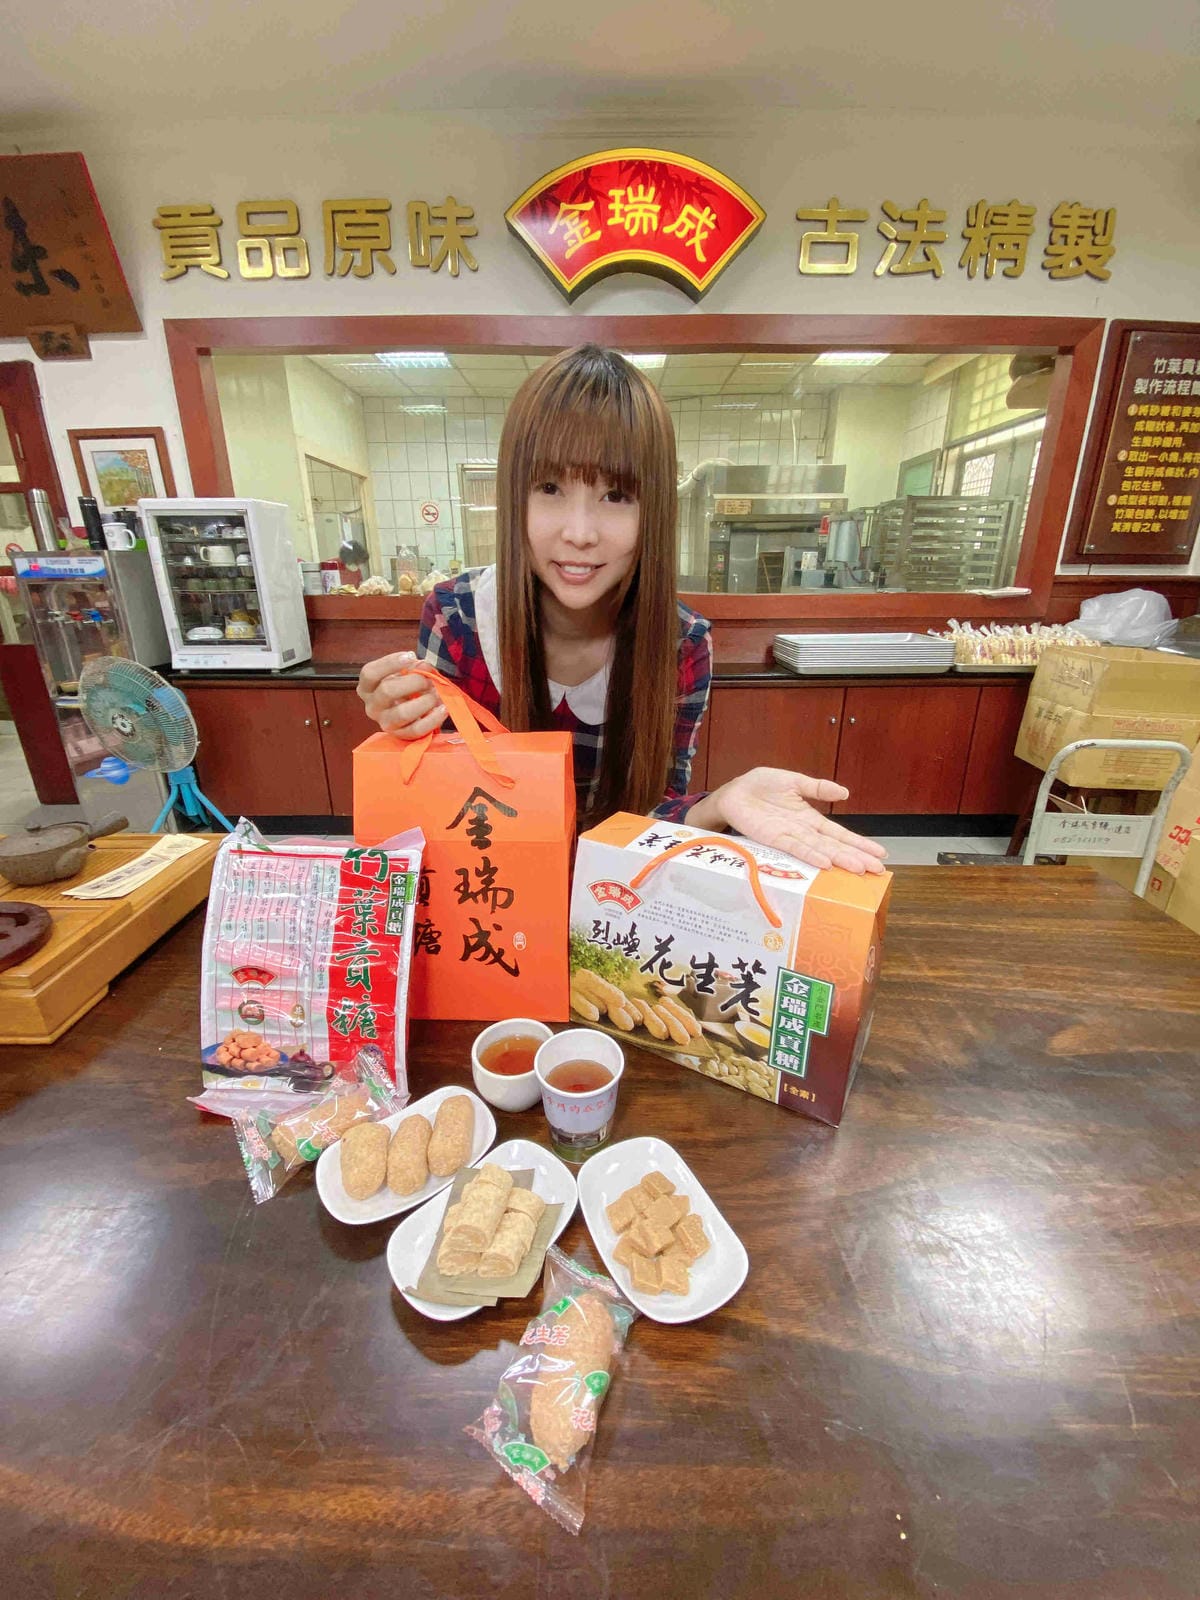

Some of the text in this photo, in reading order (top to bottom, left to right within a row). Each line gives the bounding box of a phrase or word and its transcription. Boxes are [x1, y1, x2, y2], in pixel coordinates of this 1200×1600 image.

[153, 195, 479, 281] 貢品原味
[547, 184, 723, 263] 金瑞成
[796, 197, 1118, 281] 古法精製
[446, 786, 520, 978] 金瑞成
[331, 847, 390, 1040] 竹葉貢糖
[775, 977, 810, 1072] 金瑞成貢糖
